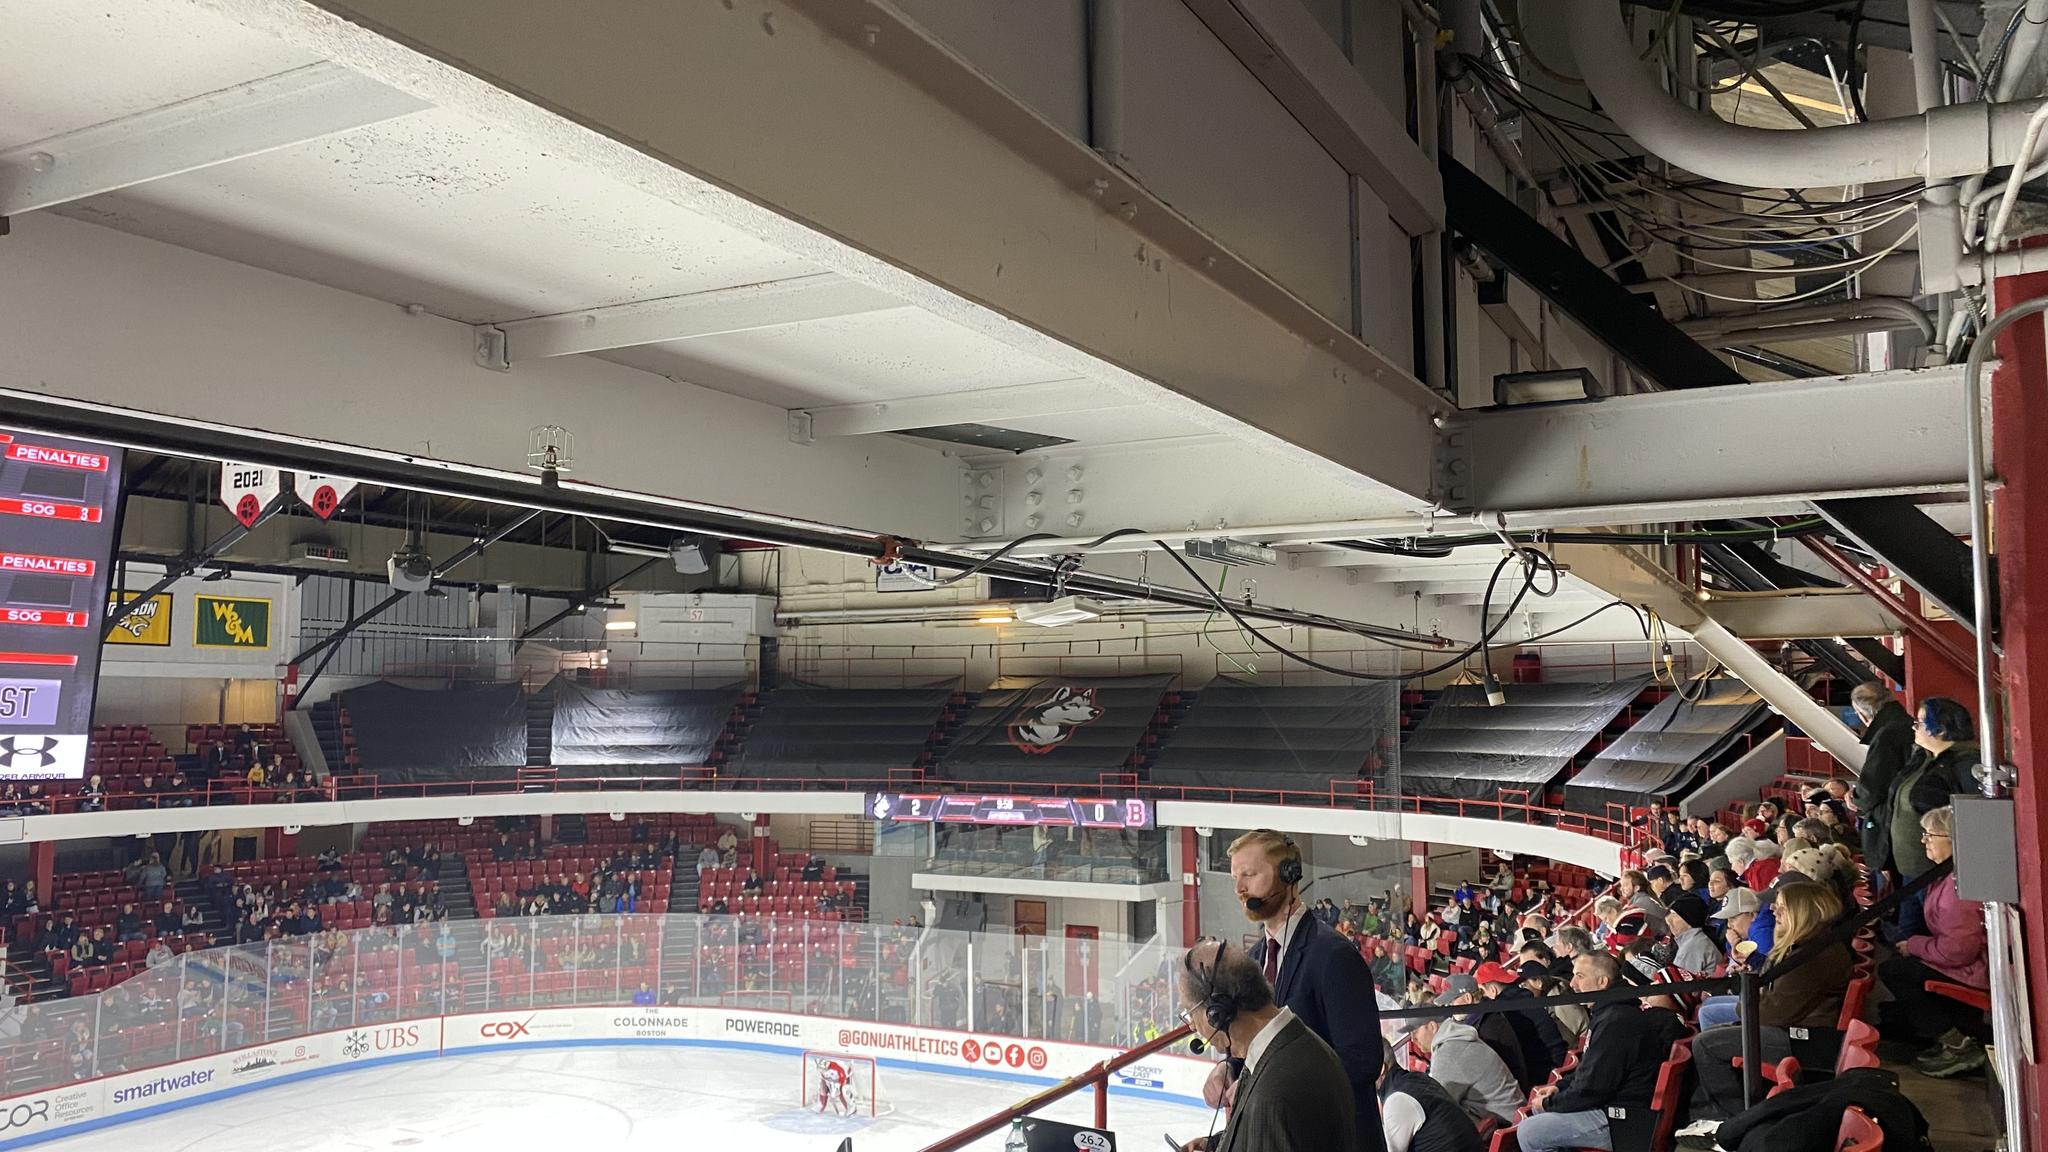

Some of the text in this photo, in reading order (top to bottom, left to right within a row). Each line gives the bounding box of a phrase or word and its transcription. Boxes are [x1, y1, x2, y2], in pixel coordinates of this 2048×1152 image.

[15, 447, 101, 467] PENALTIES
[233, 470, 263, 488] 2021
[21, 503, 89, 521] SOG 3
[2, 556, 87, 572] PENALTIES
[7, 611, 74, 625] SOG 4
[212, 602, 254, 643] W&M
[911, 799, 921, 816] 2
[1094, 804, 1105, 822] 0
[1126, 799, 1145, 826] B
[481, 1014, 537, 1039] COX
[613, 1017, 689, 1028] COLONNADE
[726, 1018, 801, 1037] POWERADE
[375, 1025, 420, 1051] UBS
[1795, 1029, 1803, 1038] C
[838, 1029, 959, 1056] @GONUATHLETICS
[1133, 1065, 1163, 1075] HOCKEY
[113, 1068, 216, 1104] smartwater
[55, 1091, 87, 1104] Creative
[54, 1105, 94, 1120] Resources
[55, 1101, 79, 1112] Office
[1614, 1109, 1621, 1118] B
[1079, 1133, 1105, 1148] 26.2
